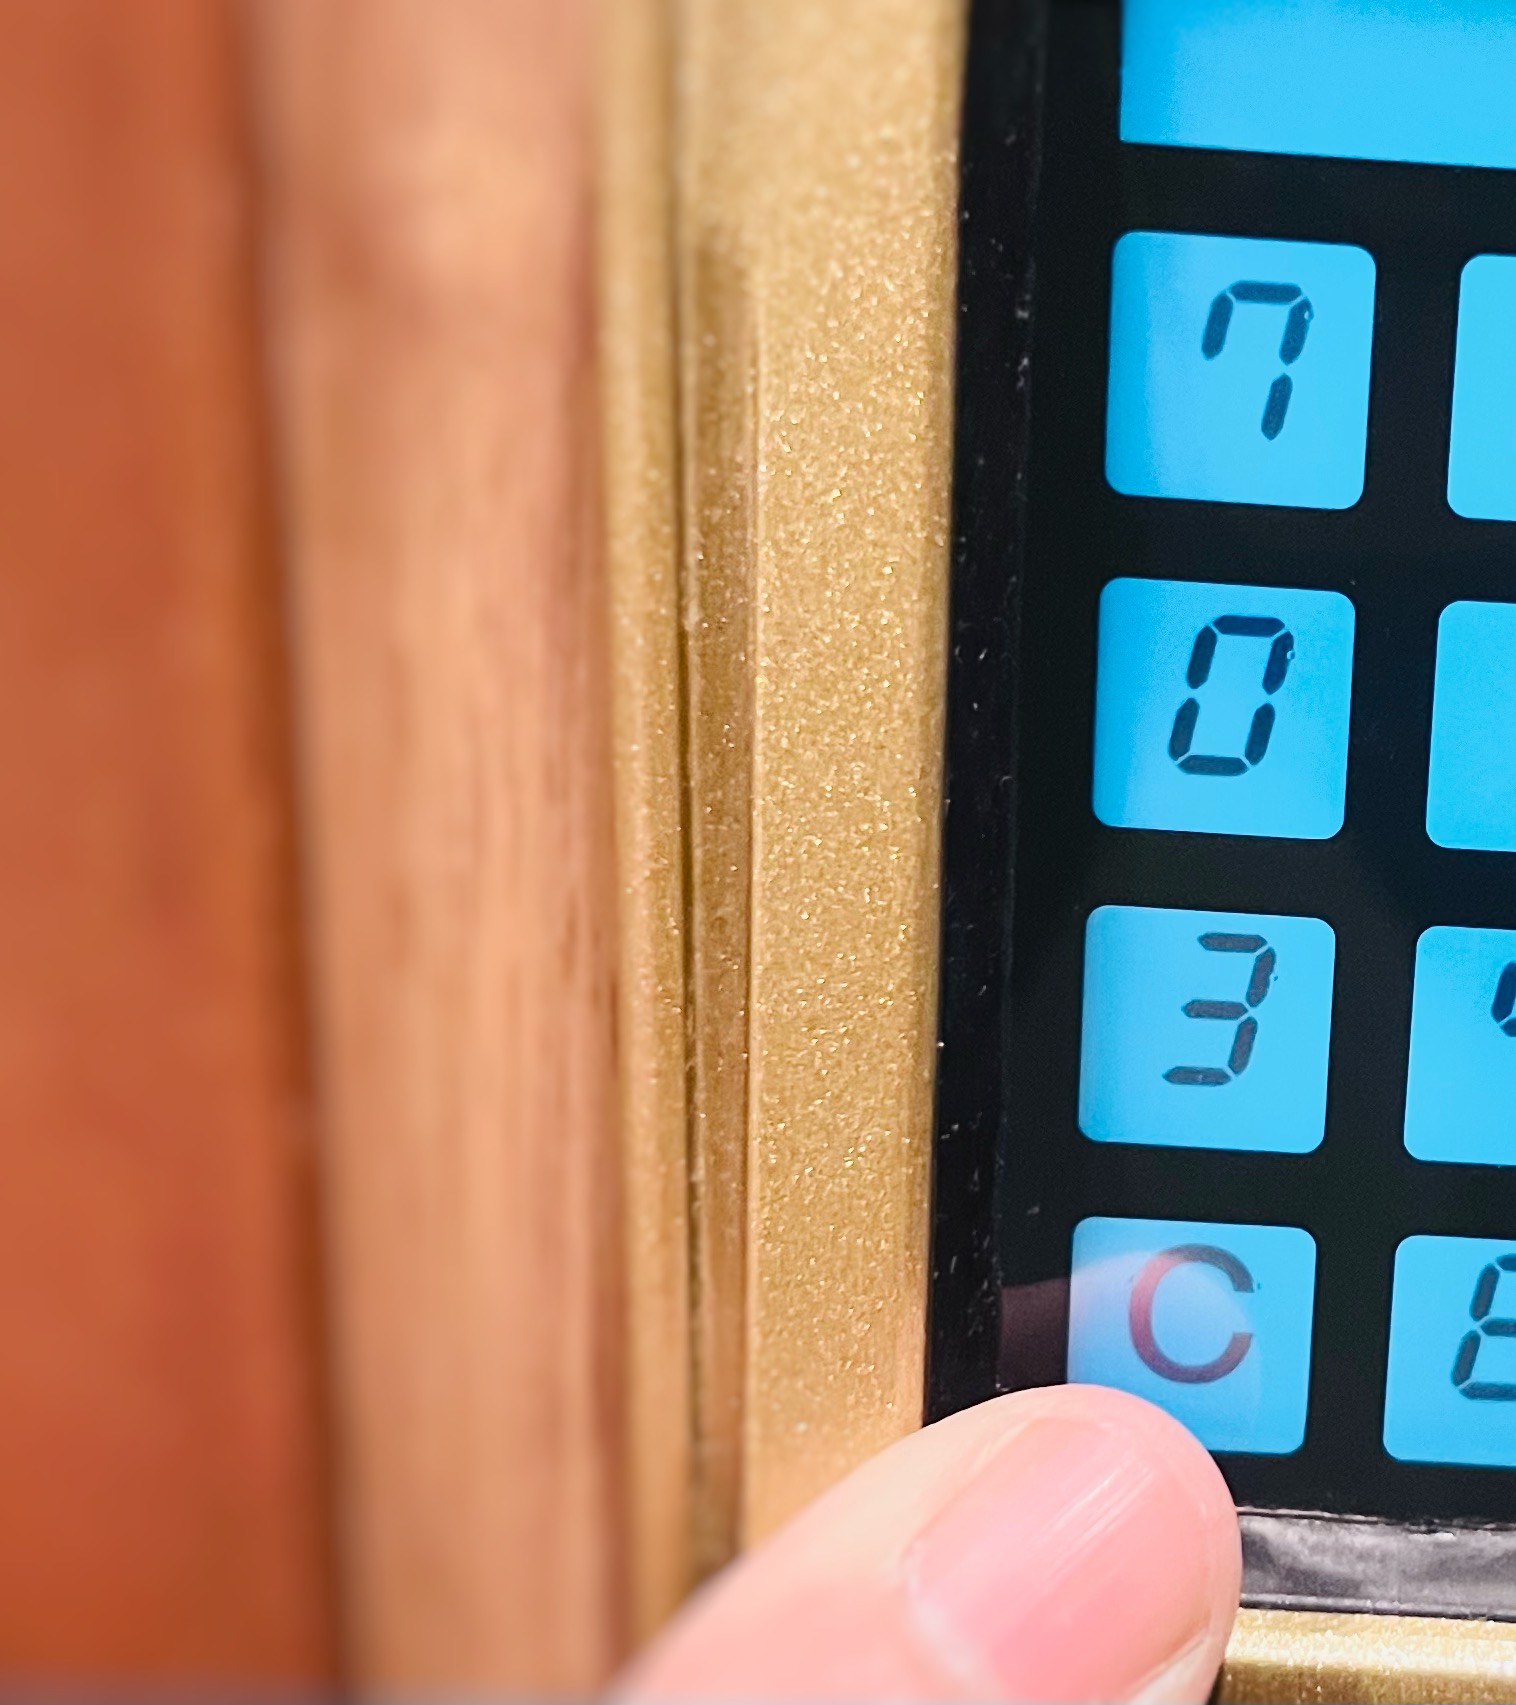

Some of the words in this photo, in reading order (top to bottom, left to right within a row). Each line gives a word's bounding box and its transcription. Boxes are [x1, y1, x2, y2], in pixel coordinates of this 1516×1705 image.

[1202, 282, 1312, 440] 7
[1169, 615, 1293, 775] 0
[1163, 933, 1276, 1086] 3
[1130, 1245, 1253, 1384] C
